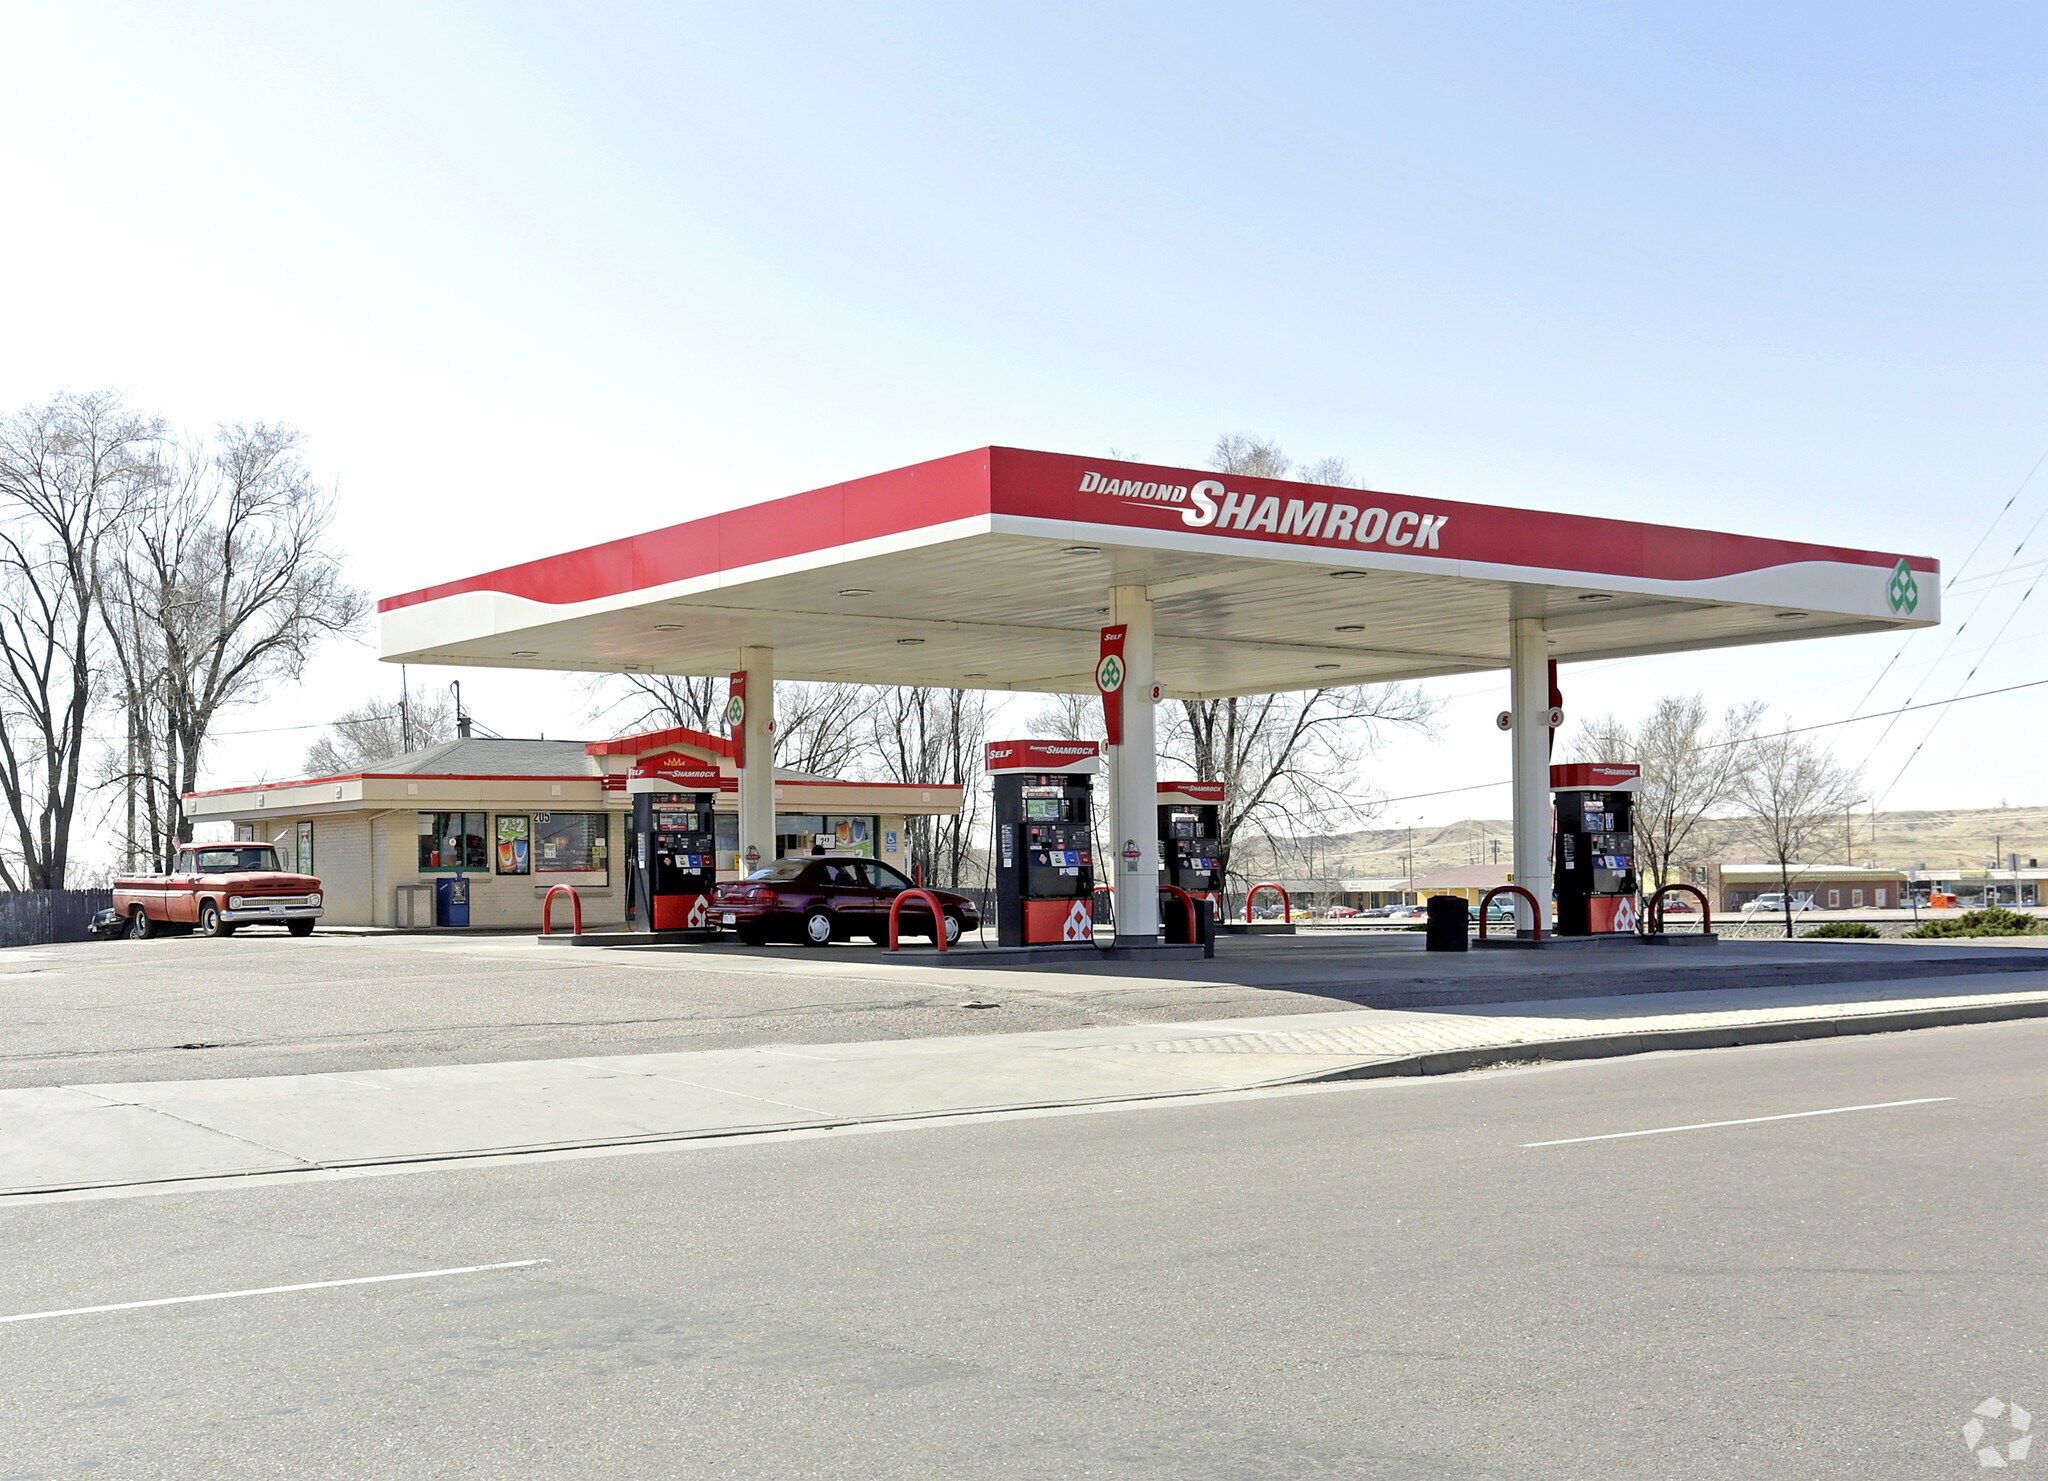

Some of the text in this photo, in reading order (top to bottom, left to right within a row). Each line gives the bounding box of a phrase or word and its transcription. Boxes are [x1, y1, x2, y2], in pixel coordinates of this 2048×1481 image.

[1079, 471, 1449, 550] DIAMOND SHAMROCK
[1104, 633, 1123, 641] SELF
[1153, 686, 1160, 699] 8
[1501, 715, 1509, 726] 5
[1551, 712, 1559, 723] 6
[768, 721, 774, 732] 4
[989, 749, 1013, 760] SELF
[1046, 745, 1095, 755] SHAMROCK
[672, 769, 716, 778] SHAMROCK
[1041, 775, 1046, 785] 8
[672, 794, 677, 802] 4
[533, 812, 550, 823] 205
[501, 818, 509, 832] 2
